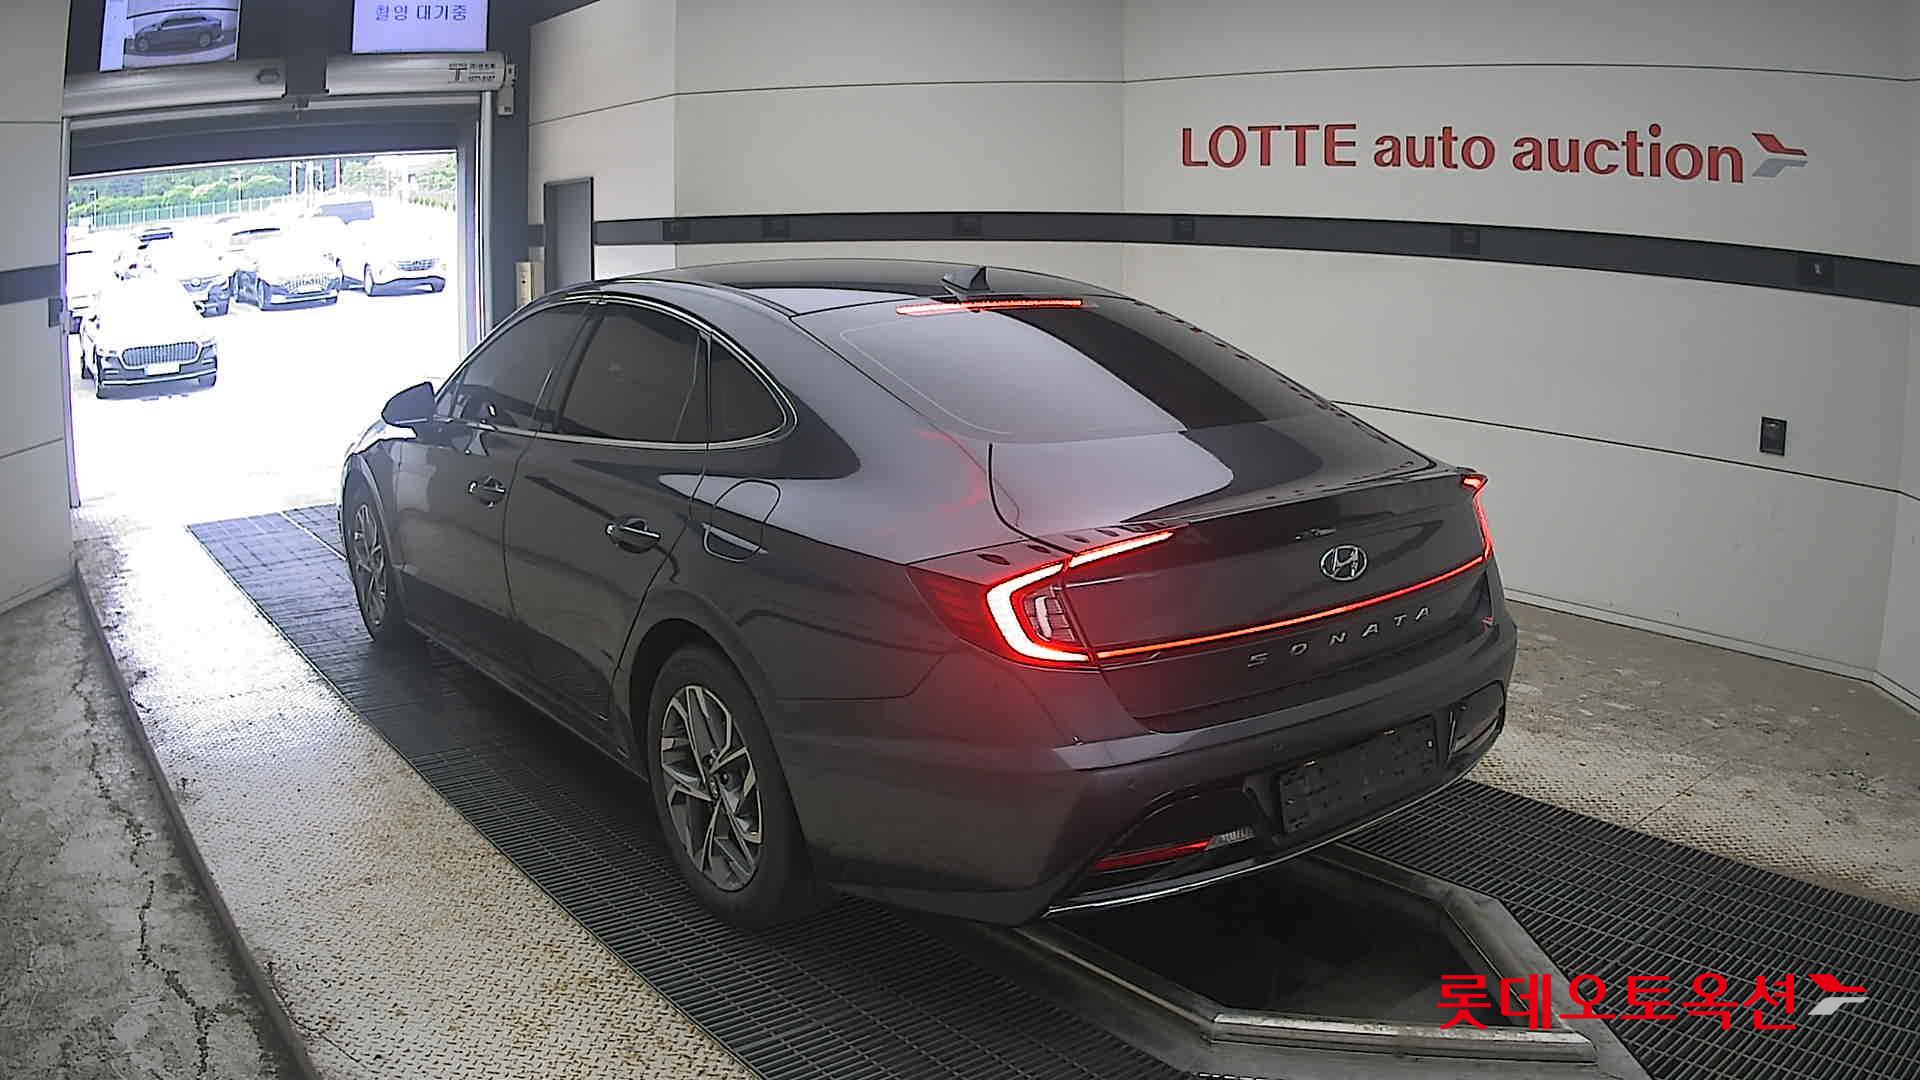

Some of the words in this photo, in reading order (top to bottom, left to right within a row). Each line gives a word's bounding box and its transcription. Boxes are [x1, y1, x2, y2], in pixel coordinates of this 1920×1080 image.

[416, 4, 467, 21] 대기중
[1182, 123, 1357, 168] LOTTE
[1373, 126, 1496, 170] auto
[1511, 123, 1744, 184] auction
[1247, 606, 1431, 668] SONATA
